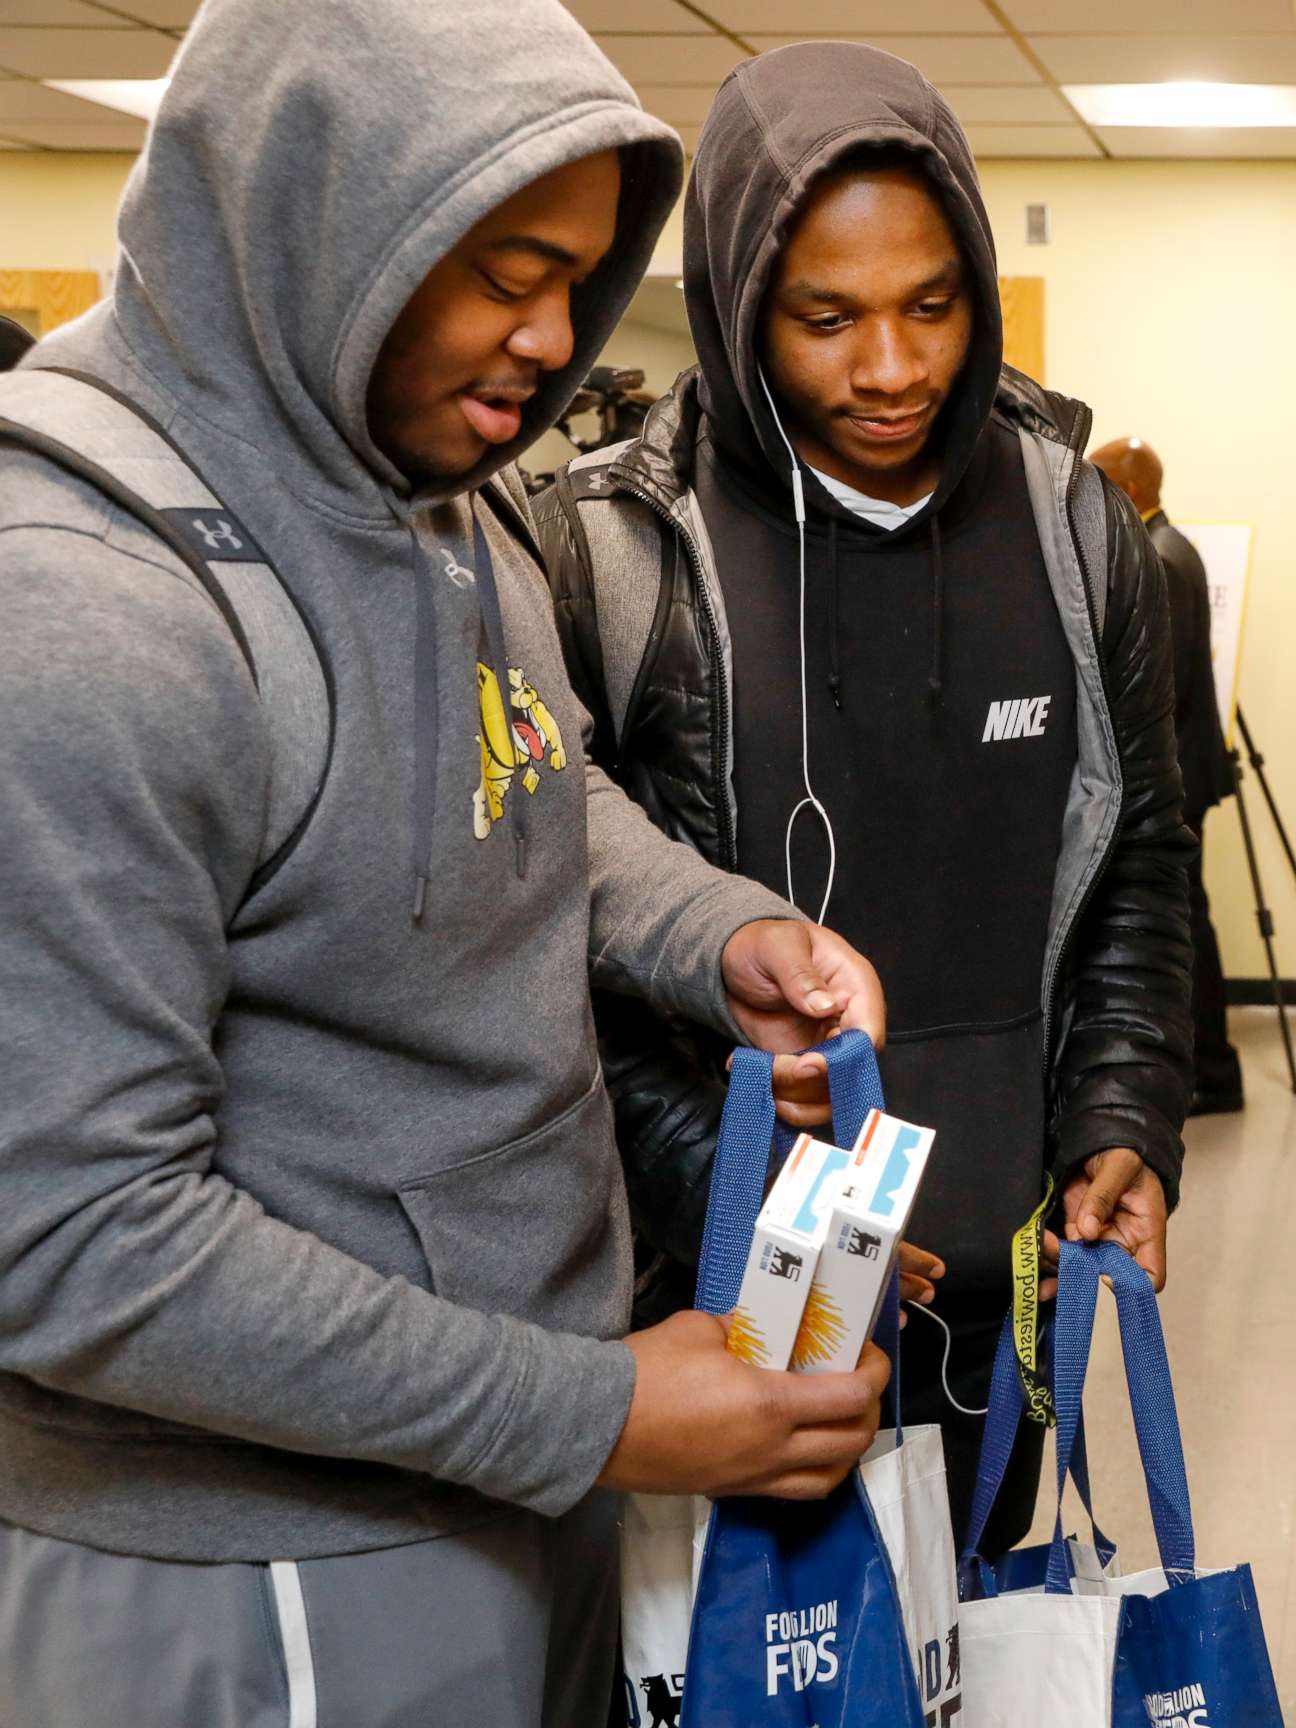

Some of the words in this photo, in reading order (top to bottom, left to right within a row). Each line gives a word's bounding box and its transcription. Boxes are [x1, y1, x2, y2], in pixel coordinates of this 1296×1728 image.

[982, 696, 1051, 743] NIKE
[800, 1600, 838, 1638] LION
[1173, 1683, 1206, 1713] LION
